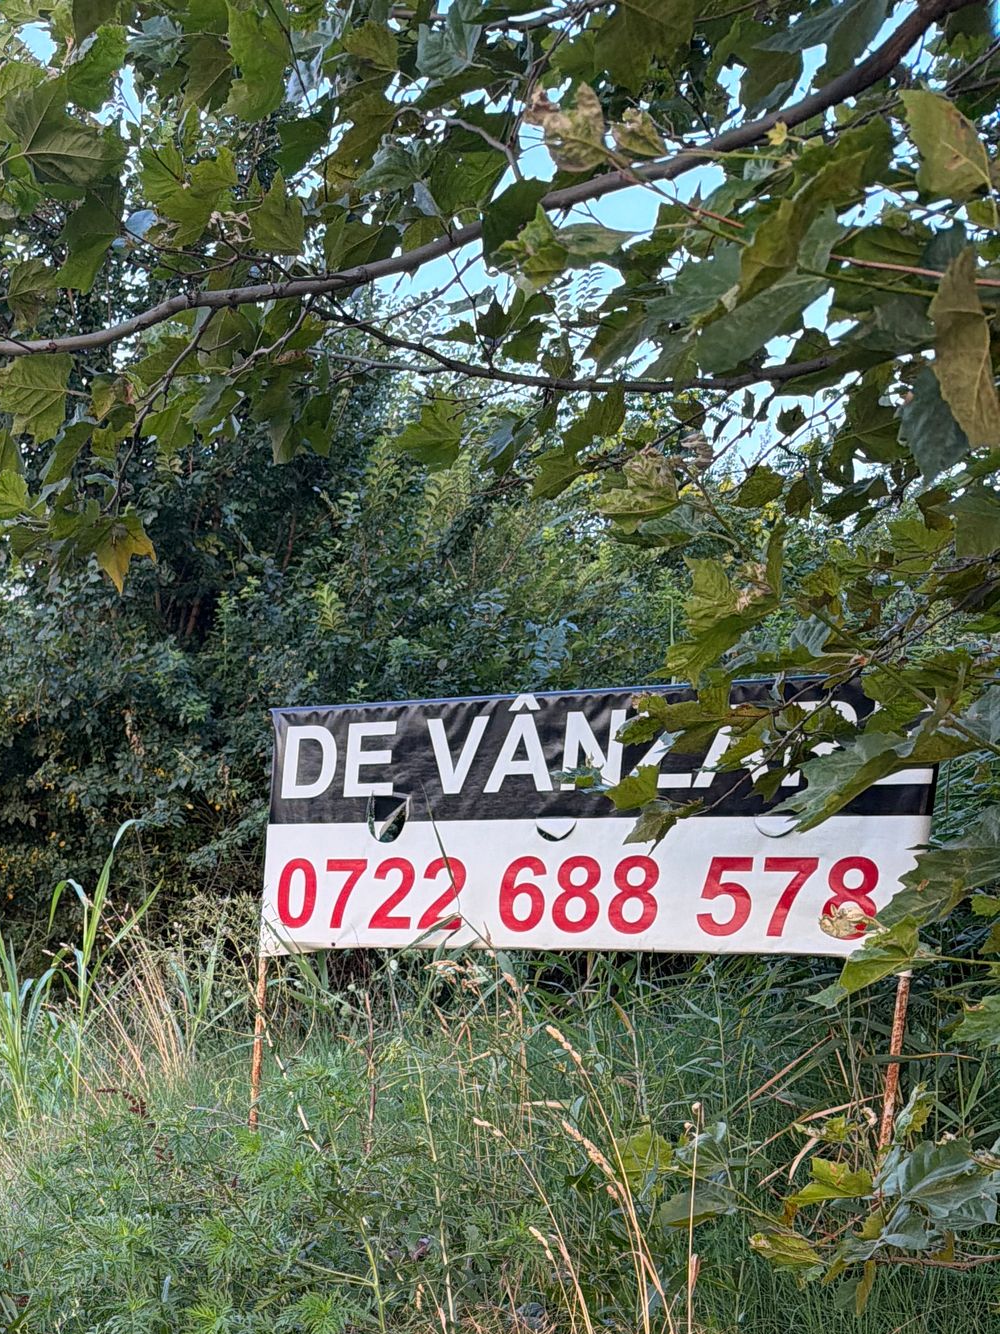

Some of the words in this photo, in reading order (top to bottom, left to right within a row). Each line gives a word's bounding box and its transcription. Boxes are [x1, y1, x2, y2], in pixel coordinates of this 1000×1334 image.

[281, 721, 398, 799] DE
[426, 693, 935, 795] VÂNA
[277, 857, 467, 930] 0722
[499, 856, 660, 935] 688
[697, 855, 880, 941] 578
